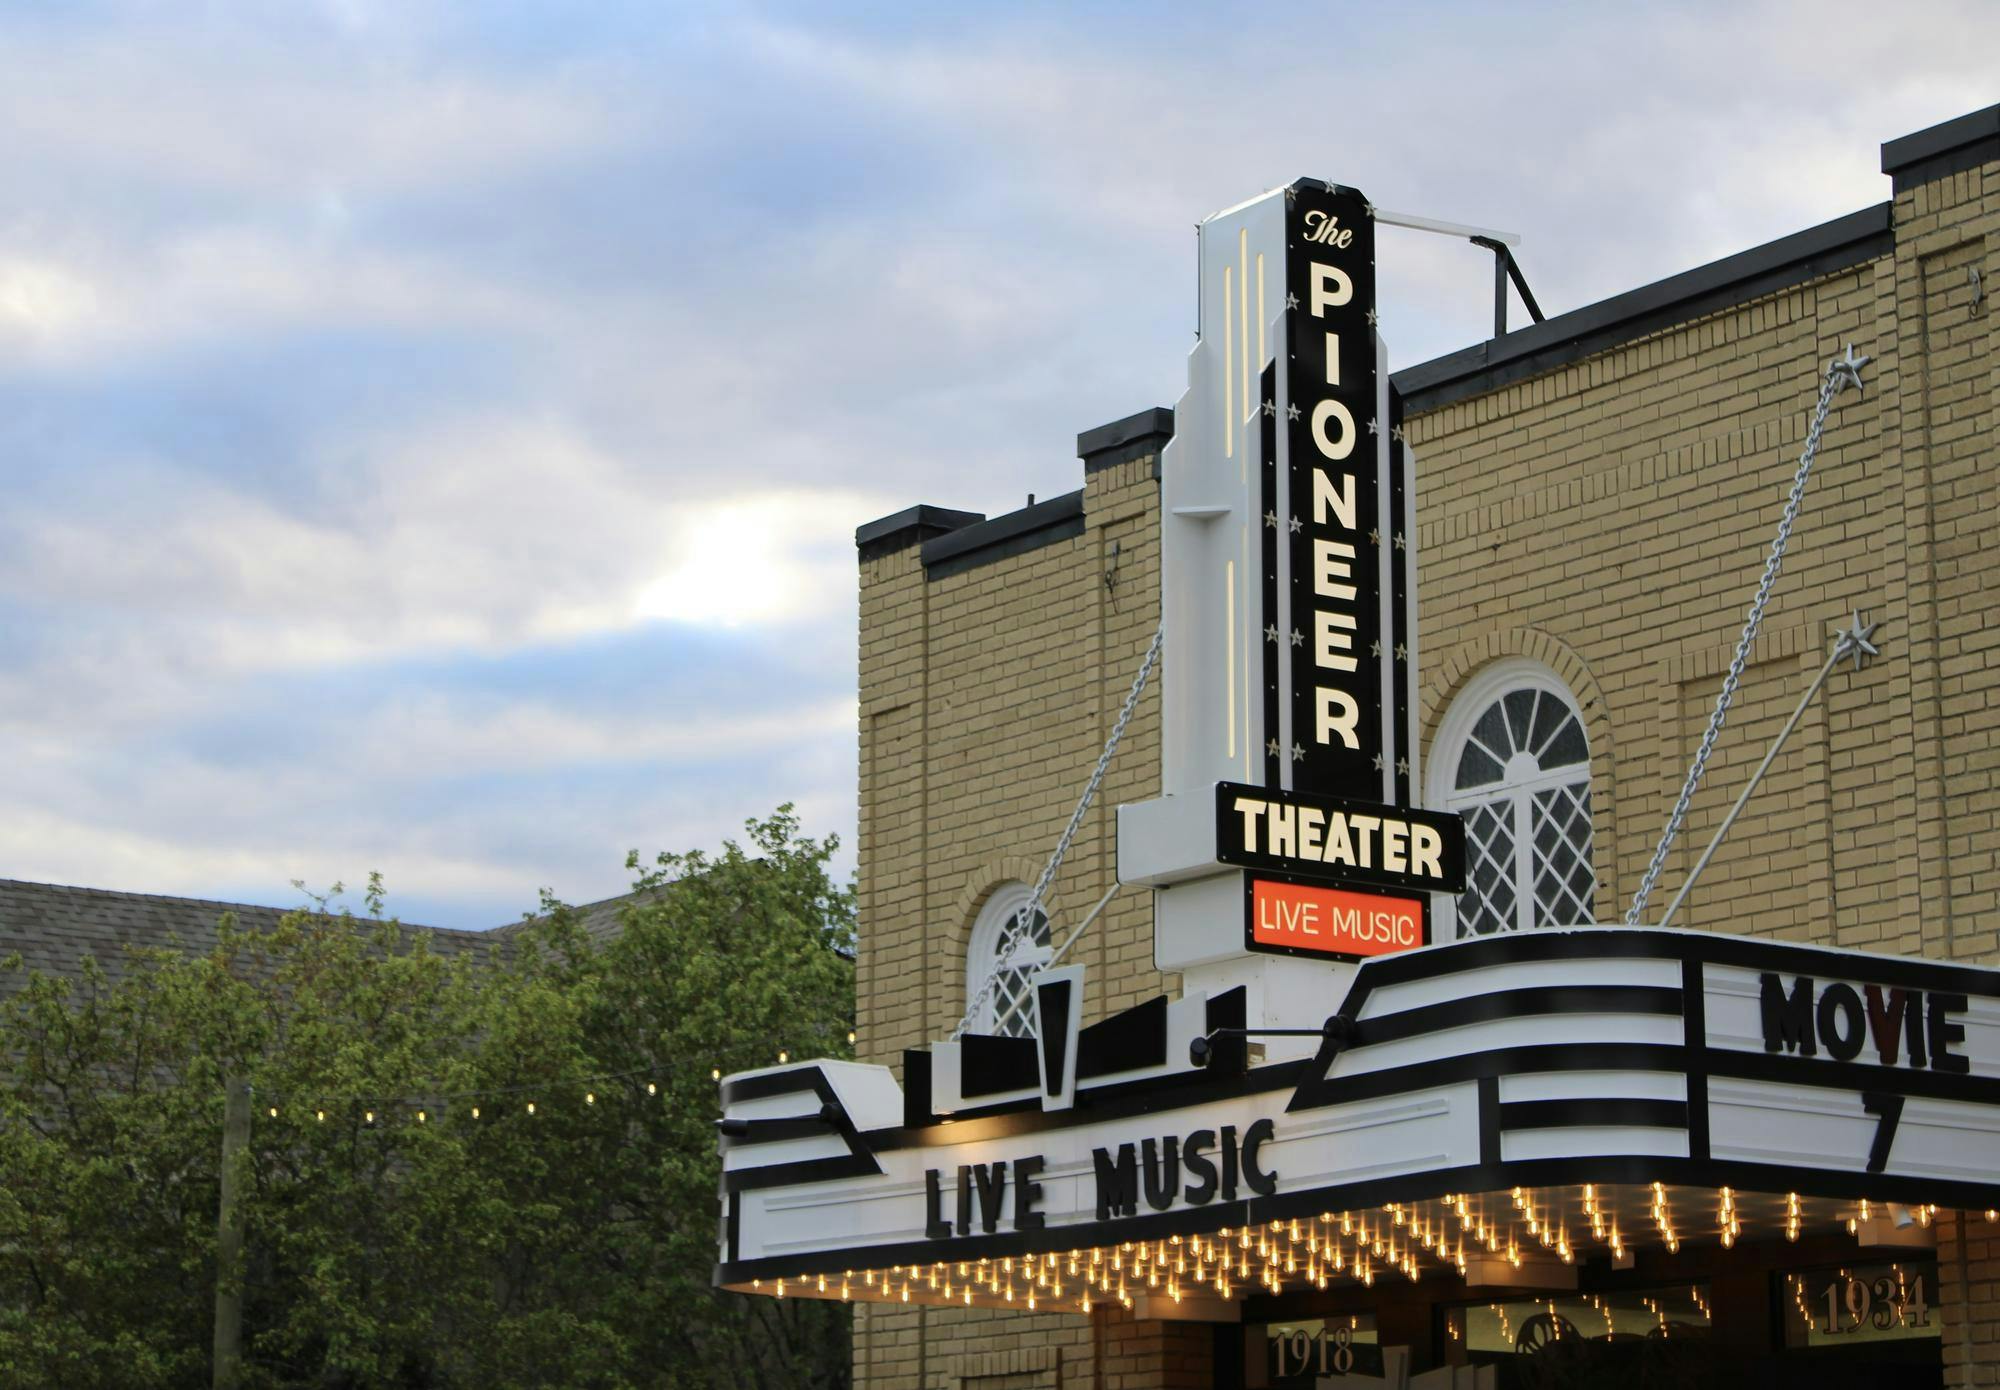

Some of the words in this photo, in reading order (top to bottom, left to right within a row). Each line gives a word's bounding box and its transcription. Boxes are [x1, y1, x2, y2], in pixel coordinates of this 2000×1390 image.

[1303, 209, 1353, 249] The
[1310, 261, 1361, 750] PIONEER
[1234, 797, 1443, 879] THEATER
[1260, 898, 1319, 934] LIVE
[1333, 907, 1415, 946] MUSIC
[1760, 973, 1970, 1074] MOVIE
[1862, 1093, 1906, 1173] 7
[925, 1155, 1046, 1239] LIVE
[1093, 1119, 1278, 1221] MUSIC
[1820, 1275, 1931, 1335] 1934
[1272, 1326, 1354, 1378] 1918
